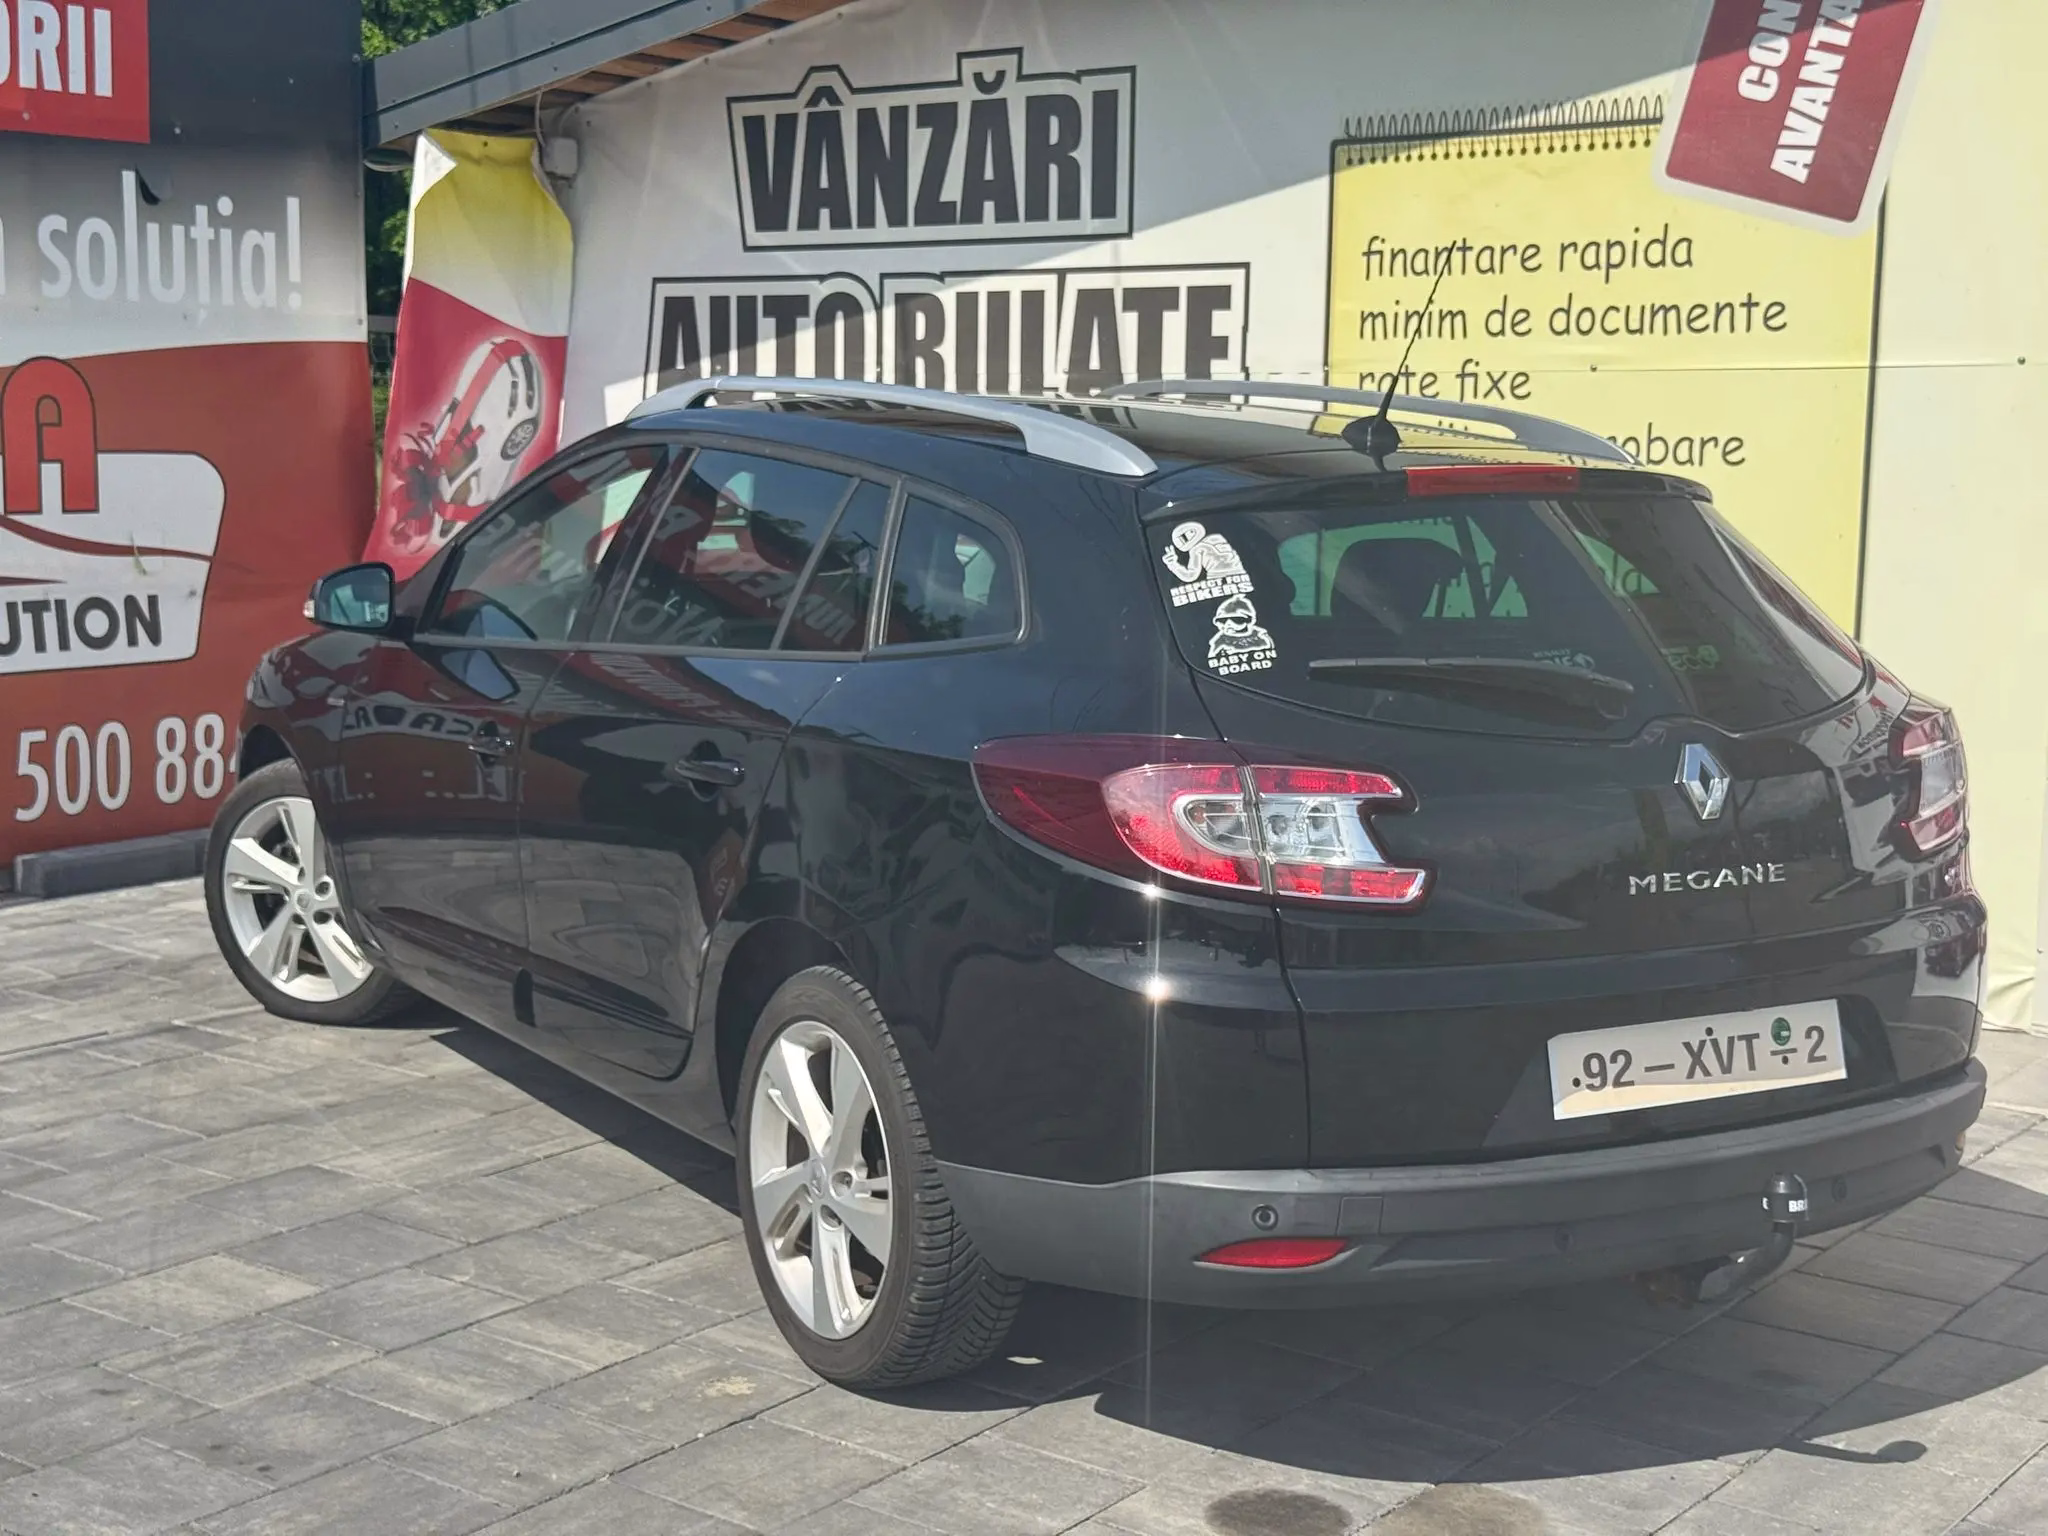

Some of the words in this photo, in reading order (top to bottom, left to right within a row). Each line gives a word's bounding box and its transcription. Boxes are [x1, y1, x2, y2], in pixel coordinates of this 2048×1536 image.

[0, 0, 112, 98] RII
[1738, 0, 1802, 102] CON
[742, 70, 1120, 233] VÂNZĂRI
[1361, 235, 1543, 282] finantare
[1559, 222, 1694, 285] rapida
[1359, 299, 1468, 341] minim
[1485, 294, 1532, 339] de
[1549, 291, 1788, 337] documente
[657, 291, 867, 386] AUTO
[894, 285, 1232, 398] RULATE
[1455, 358, 1532, 403] fixe
[1170, 578, 1223, 597] RESPECT
[1225, 573, 1251, 585] FOR
[1172, 582, 1255, 607] BIKERS
[1208, 653, 1249, 669] BABY
[1253, 649, 1278, 661] ON
[1217, 660, 1273, 676] BOARD
[15, 720, 132, 822] 500
[156, 712, 237, 805] 88
[1628, 862, 1787, 896] MEGANE
